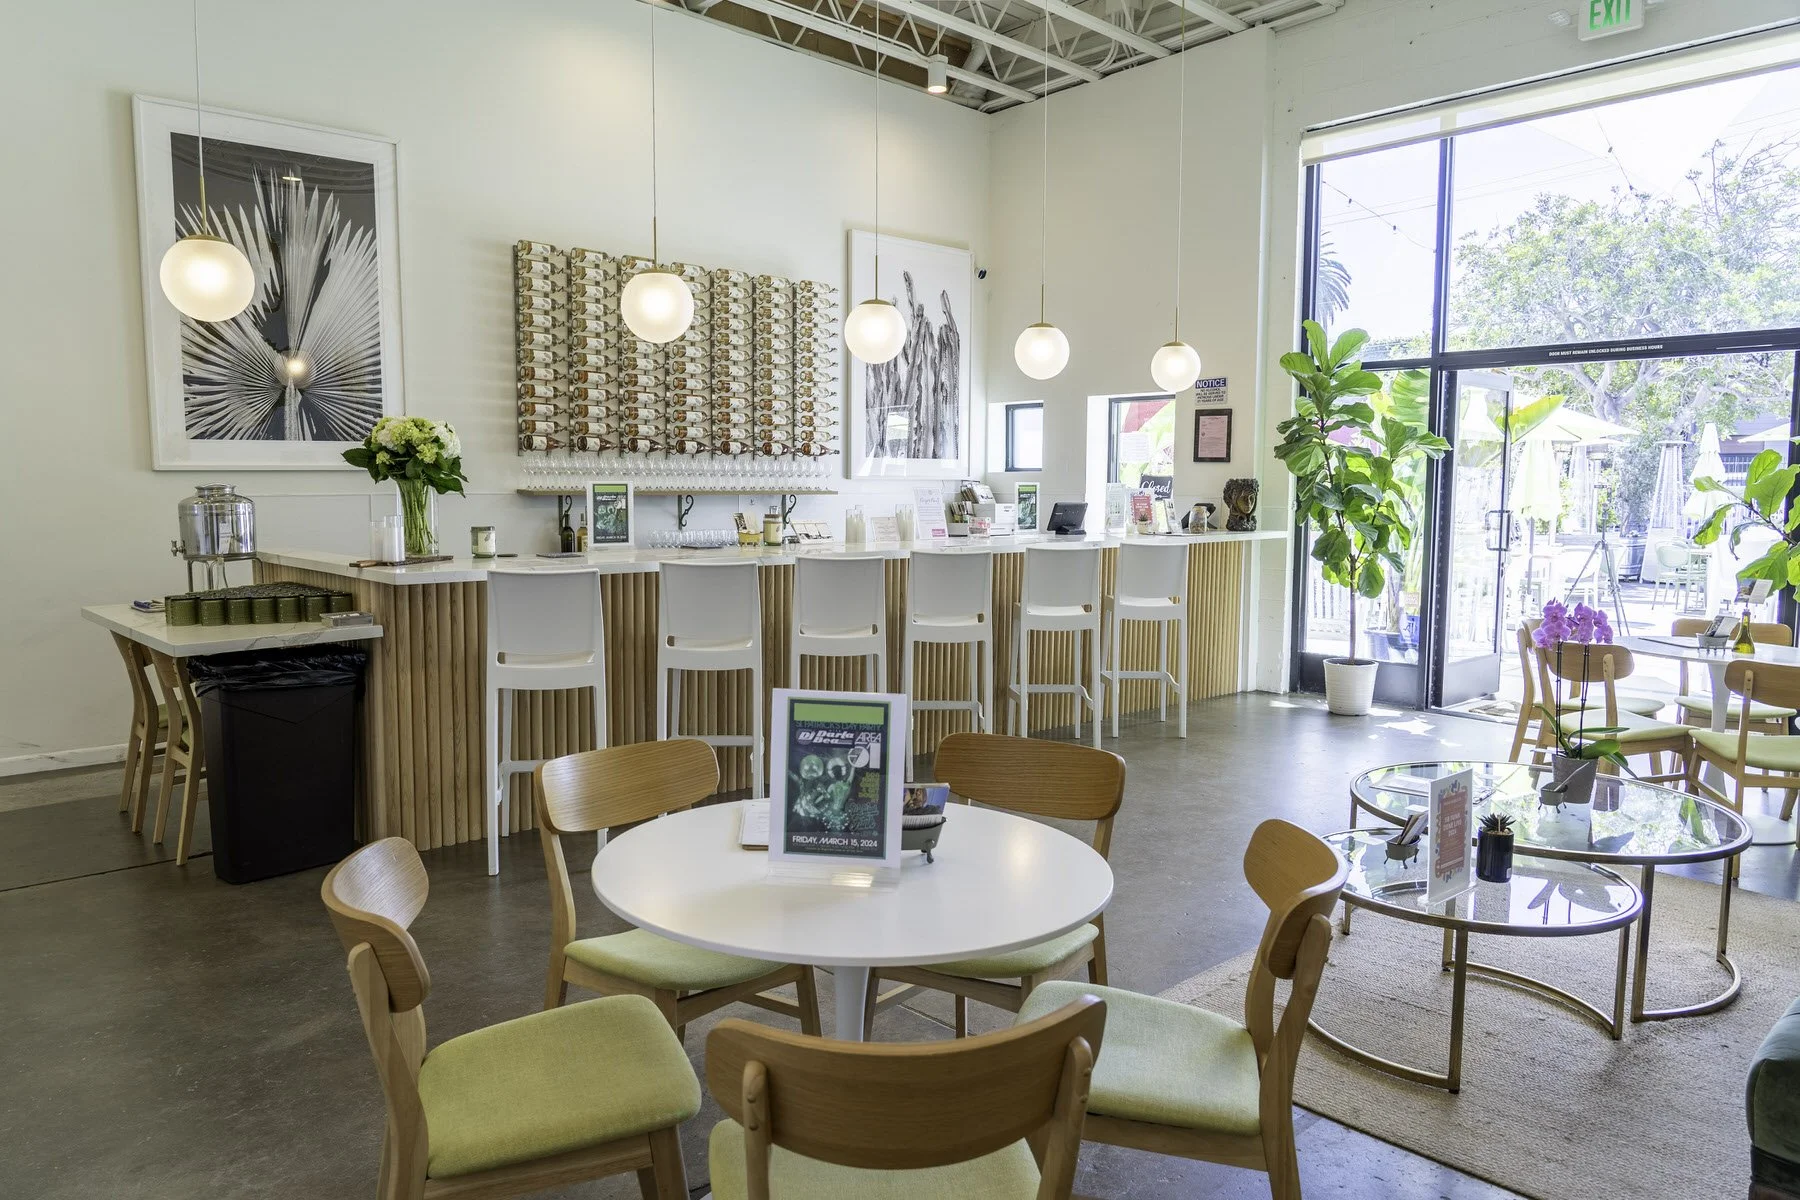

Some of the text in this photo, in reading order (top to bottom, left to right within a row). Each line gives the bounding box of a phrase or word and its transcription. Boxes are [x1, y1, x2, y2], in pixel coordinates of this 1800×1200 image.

[1590, 0, 1631, 31] EXIT
[1196, 379, 1225, 388] NOTICE
[855, 732, 882, 743] AREA
[792, 835, 878, 847] FRIDAY, MARCH 15, 2024
